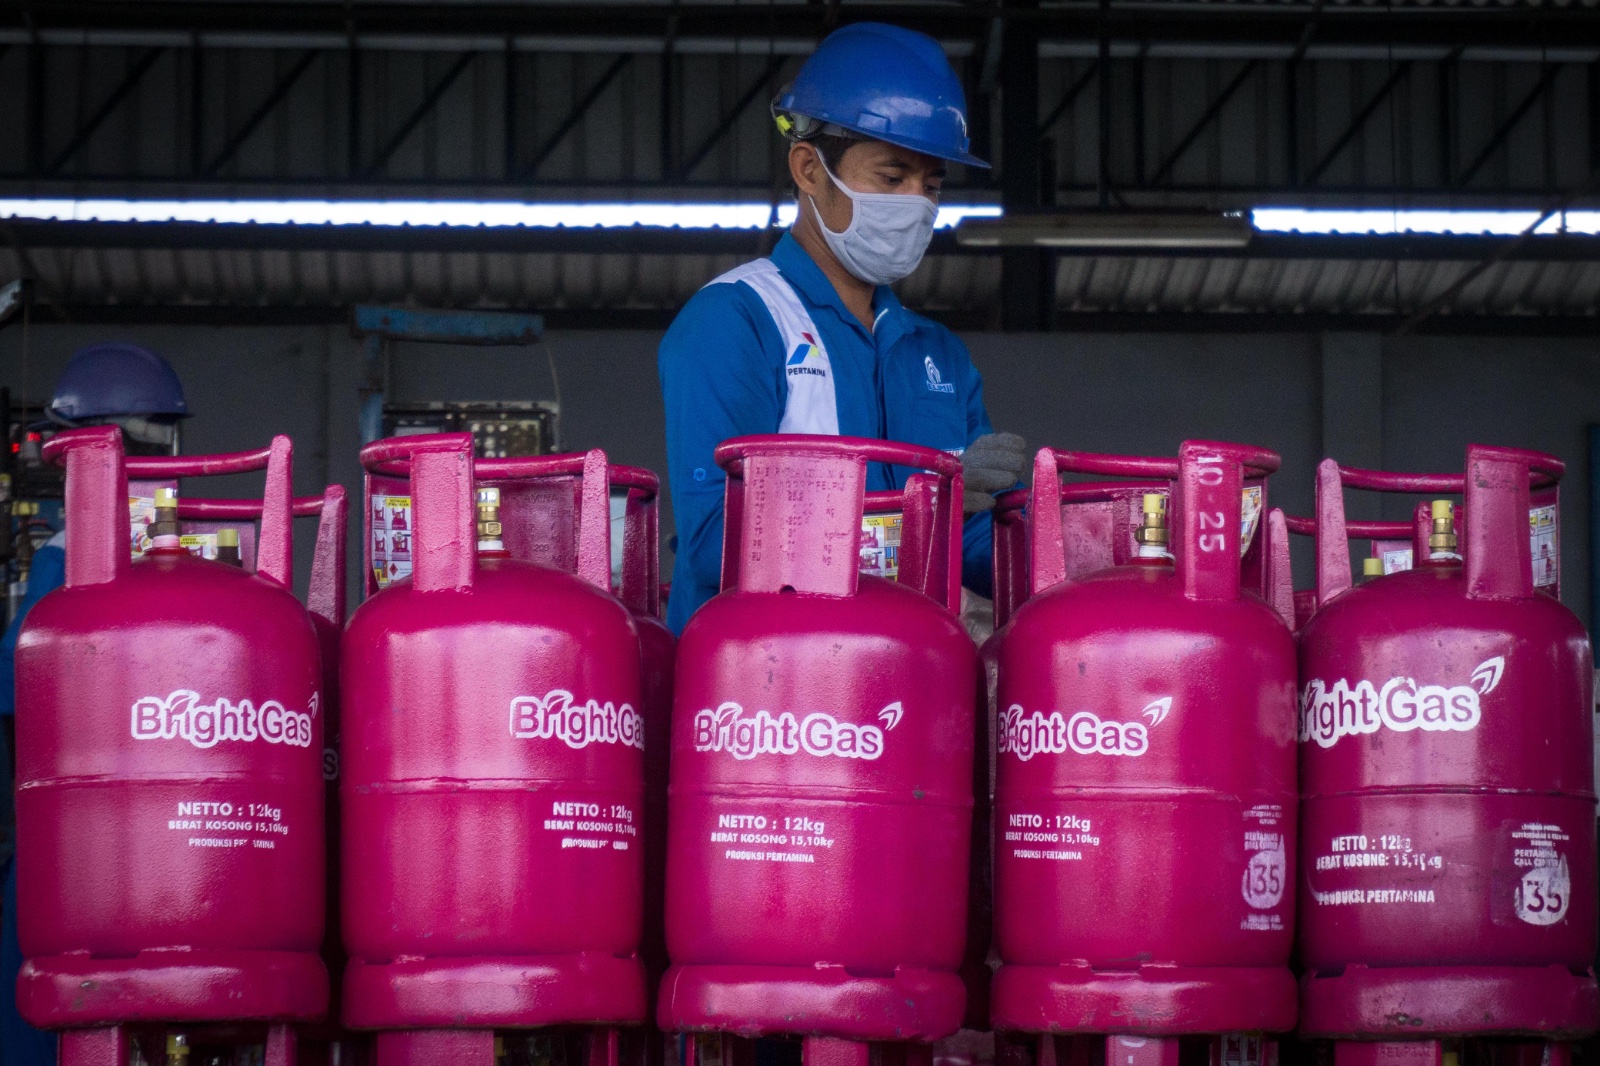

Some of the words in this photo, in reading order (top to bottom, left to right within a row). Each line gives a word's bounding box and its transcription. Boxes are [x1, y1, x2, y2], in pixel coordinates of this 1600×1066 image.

[788, 367, 826, 377] PERTAMINA
[1197, 454, 1224, 486] 10
[1199, 511, 1225, 552] 25
[131, 689, 257, 748] Bright
[258, 701, 311, 748] Gas
[509, 689, 618, 749] Bright
[618, 703, 644, 751] Ga
[1299, 678, 1381, 748] right
[1379, 676, 1481, 732] Gas
[694, 702, 798, 760] Bright
[800, 713, 883, 760] Gas
[998, 704, 1067, 761] Bright
[1067, 712, 1148, 756] Gas
[178, 802, 233, 816] NETTO
[249, 803, 281, 821] 12kg
[553, 802, 599, 817] NETTO
[611, 805, 632, 823] 12kg
[168, 820, 202, 830] BERAT
[206, 821, 253, 832] KOSONG
[255, 822, 288, 835] 15,10kg
[544, 820, 574, 830] BERAT
[577, 821, 613, 832] KOSONG
[719, 814, 767, 829] NETTO
[784, 817, 825, 835] 12kg
[1009, 814, 1042, 828] NETTO
[1055, 815, 1091, 832] 12kg
[189, 838, 232, 848] PRODUKSI
[711, 832, 738, 843] BERAT
[741, 834, 787, 845] KOSONG
[791, 835, 834, 848] 15,10kg
[1005, 832, 1022, 841] BERAT
[1023, 832, 1058, 843] KOSONG
[1061, 834, 1100, 846] 15,10kg
[1331, 836, 1368, 852] NETTO
[725, 850, 764, 861] PRODUKSI
[766, 852, 815, 863] PERTAMINA
[1013, 849, 1041, 859] PRODUKSI
[1042, 851, 1082, 860] PERTAMINA
[1366, 890, 1435, 903] PERTAMINA
